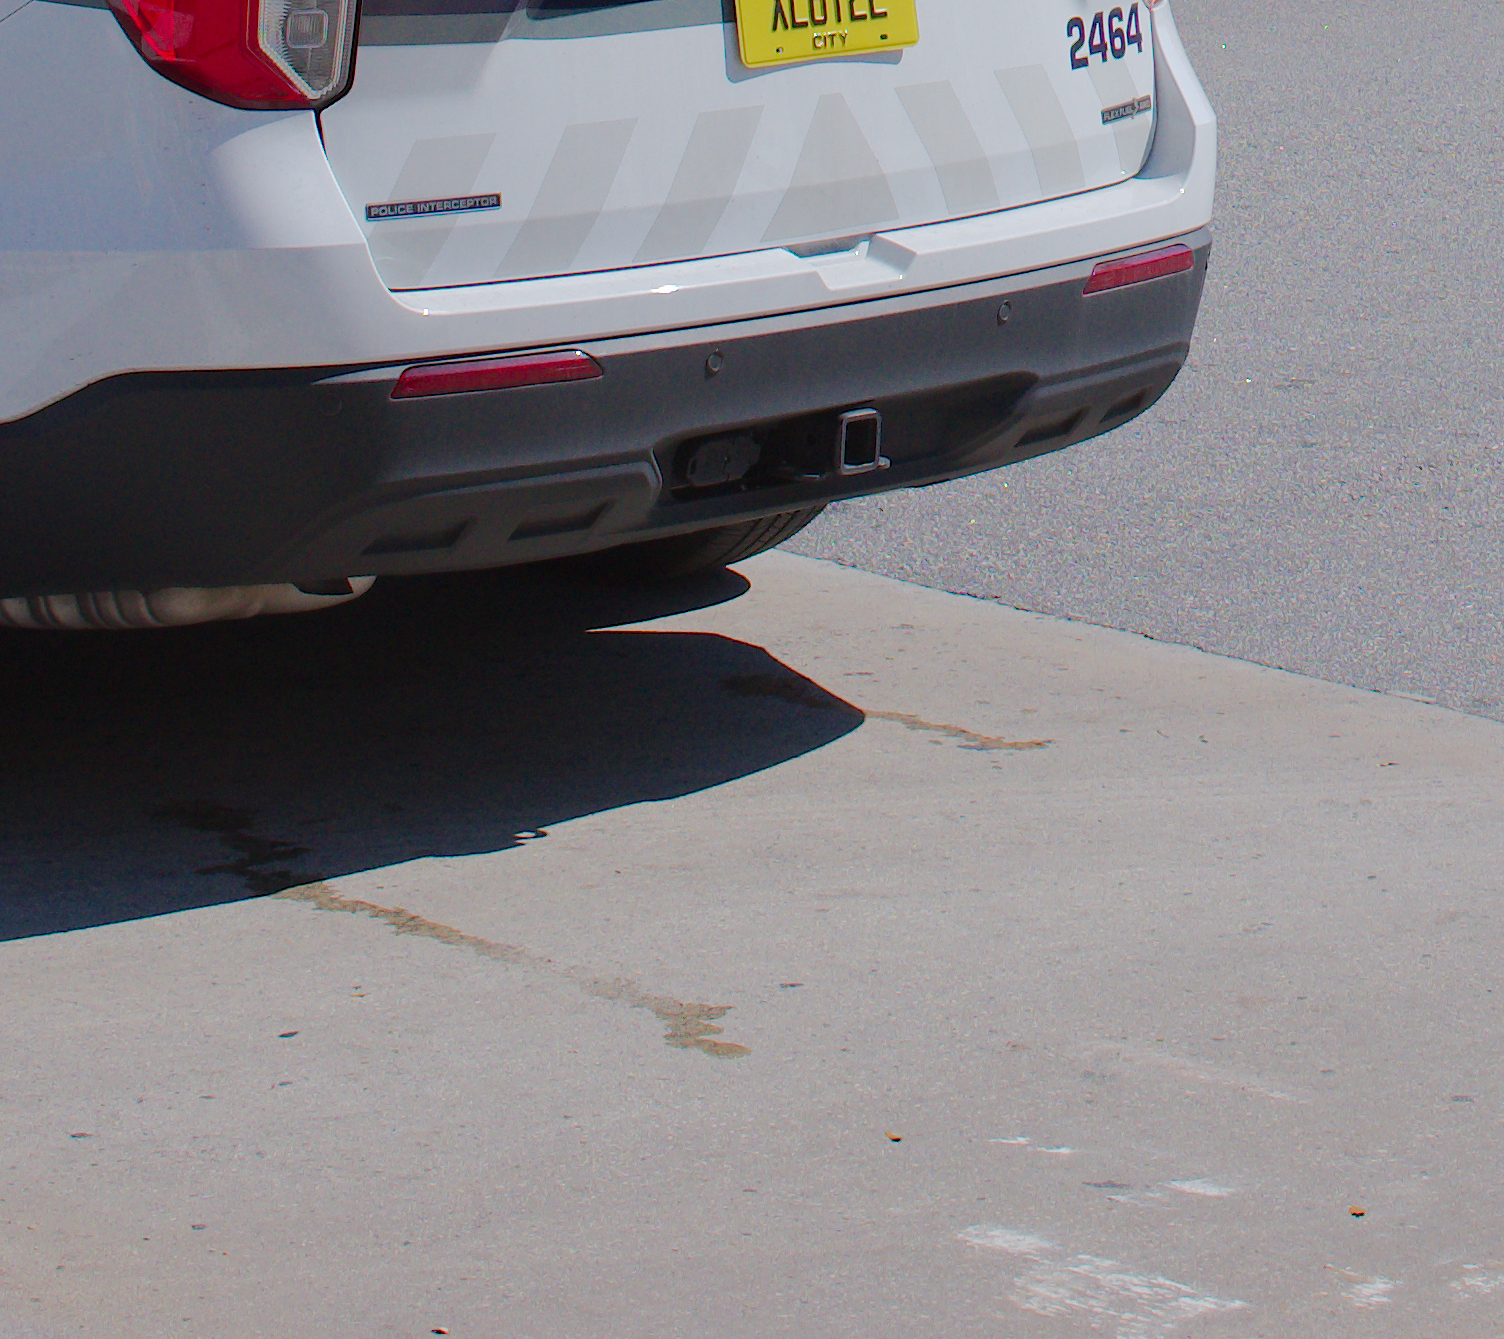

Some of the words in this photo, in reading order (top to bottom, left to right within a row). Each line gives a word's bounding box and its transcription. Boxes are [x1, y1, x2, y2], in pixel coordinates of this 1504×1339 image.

[812, 29, 849, 50] CITY
[1066, 1, 1143, 71] 2464
[370, 205, 415, 217] POLICE
[417, 196, 498, 213] INTERCEPTOR
